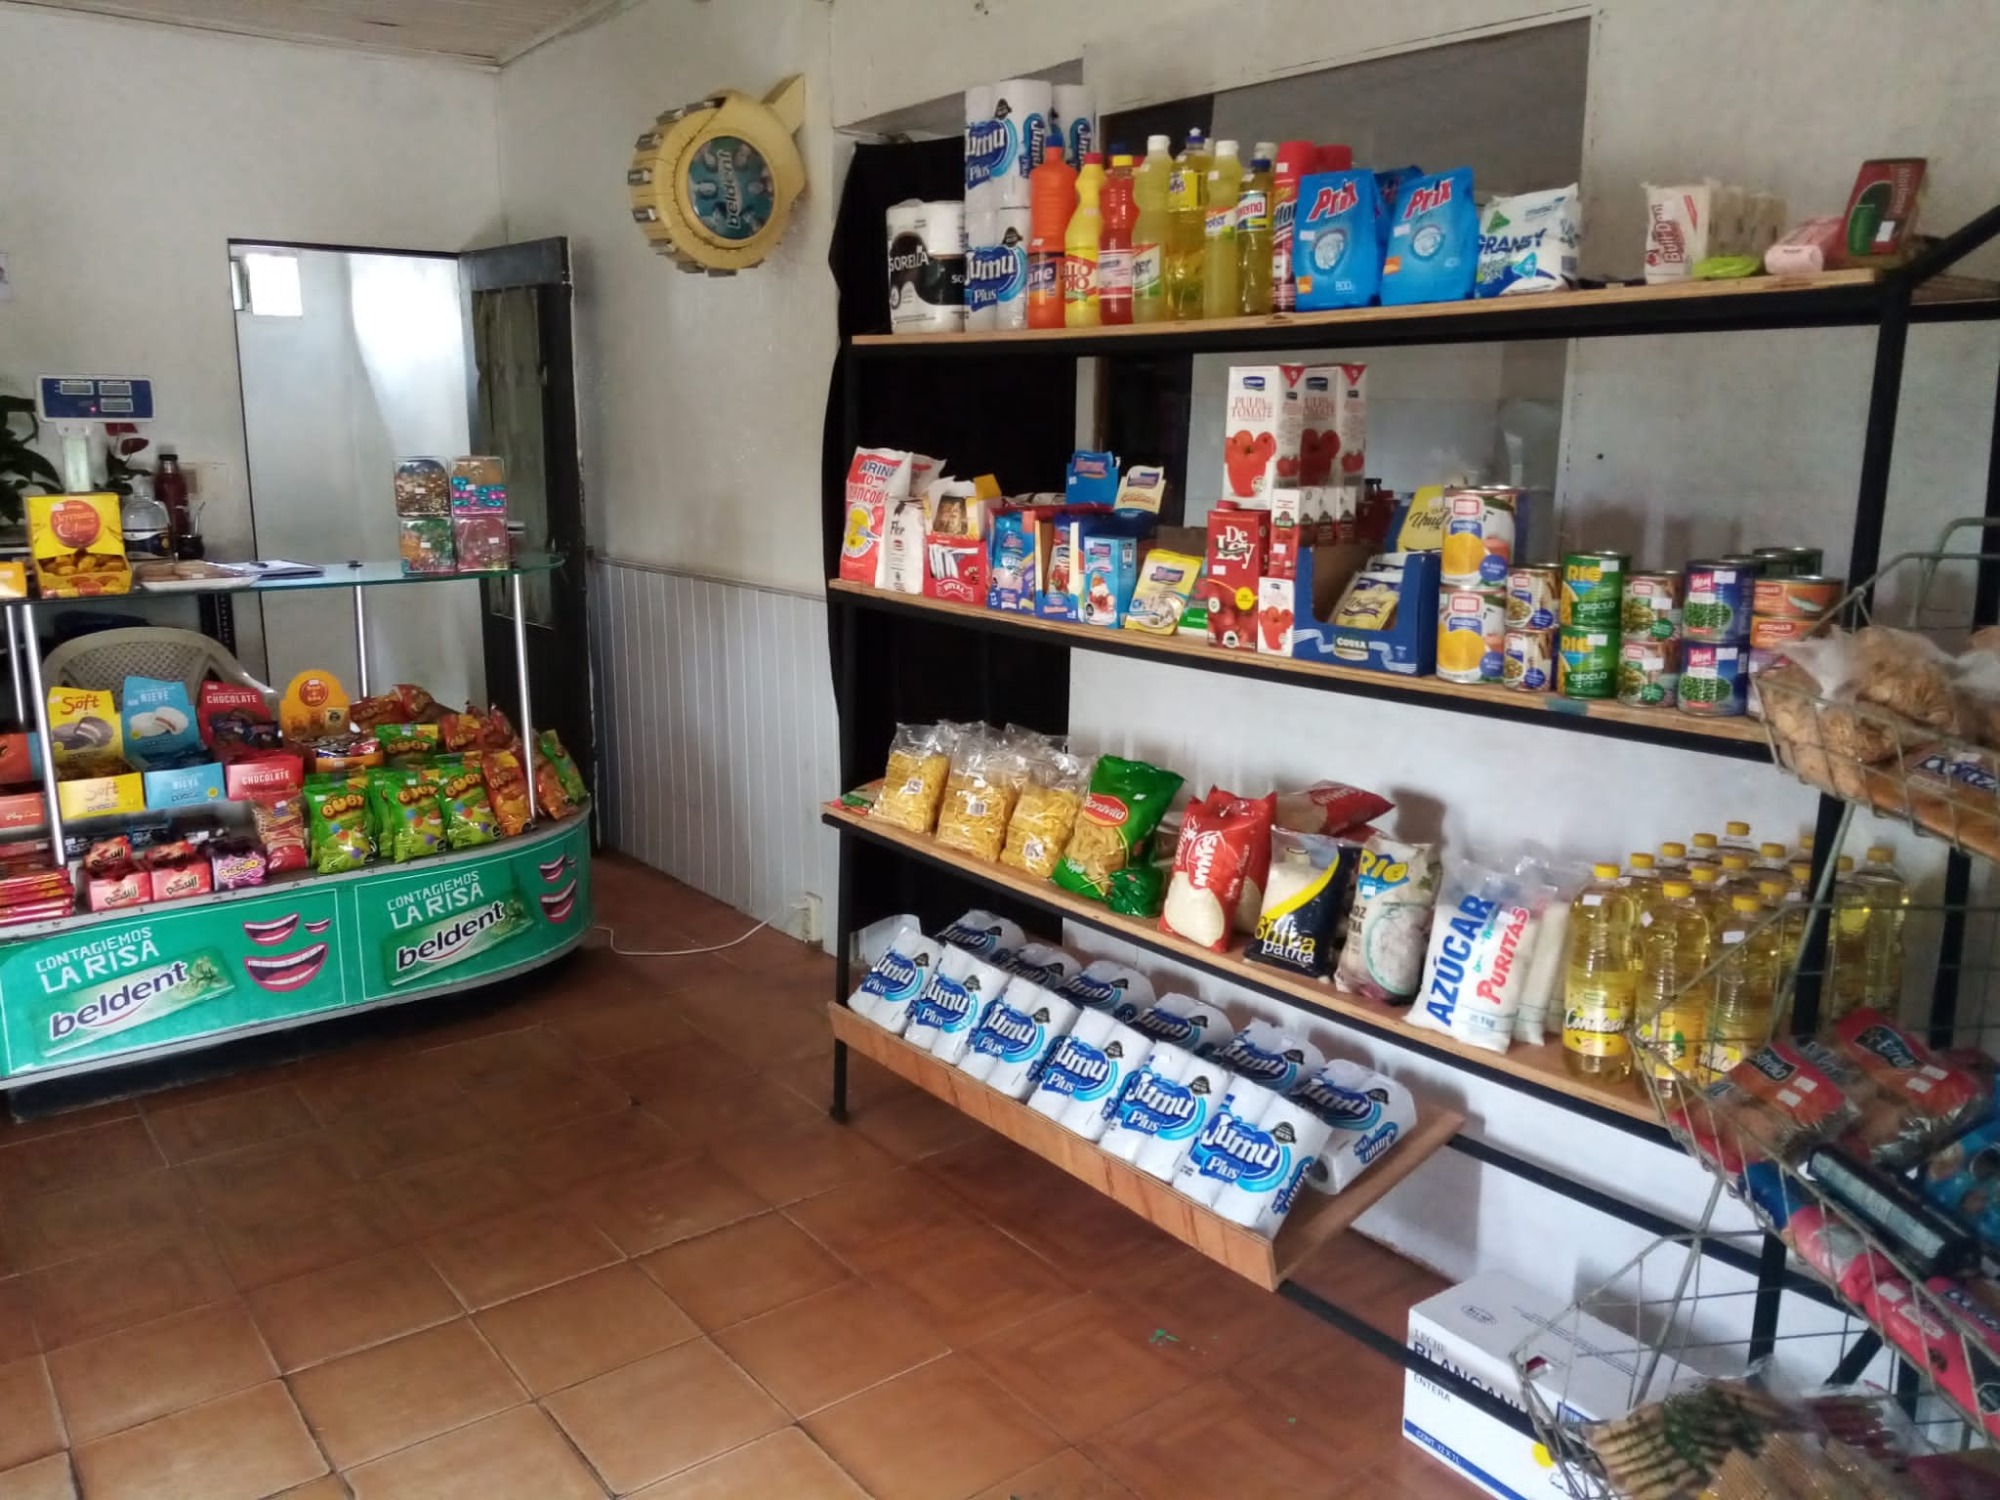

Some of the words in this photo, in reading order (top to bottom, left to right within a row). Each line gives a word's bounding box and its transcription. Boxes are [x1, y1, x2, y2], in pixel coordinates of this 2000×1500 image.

[717, 149, 741, 230] beldent
[968, 165, 991, 182] Plus
[1306, 181, 1359, 222] Prix
[1403, 178, 1454, 221] Prix
[973, 286, 998, 304] Plus
[1215, 533, 1256, 570] Ley
[1225, 525, 1249, 543] De
[60, 694, 101, 716] Soft
[206, 694, 258, 705] CHOCOLATE
[241, 770, 291, 785] CHOCOLATE
[386, 870, 480, 912] CONTAGIEMOS
[390, 904, 422, 930] LA
[425, 881, 485, 918] RISA
[35, 926, 153, 973] CONTAGIEMOS
[397, 901, 505, 971] beldent
[41, 966, 82, 994] LA
[85, 939, 160, 980] RISA
[1426, 894, 1496, 1028] AZÚCAR
[51, 960, 188, 1041] beldent
[866, 976, 887, 993] Plus
[921, 972, 969, 1013] Jumu
[921, 1006, 944, 1026] Plus
[981, 1003, 1035, 1044] Jumu
[979, 1036, 1005, 1055] Plus
[1051, 1036, 1108, 1081] Jumu
[1050, 1074, 1076, 1093] Plus
[1125, 1071, 1197, 1120] Jumu
[1129, 1110, 1162, 1133] Plus
[1202, 1113, 1279, 1169] Jumu
[1206, 1155, 1241, 1180] Plus
[1413, 1373, 1451, 1403] ENTERA
